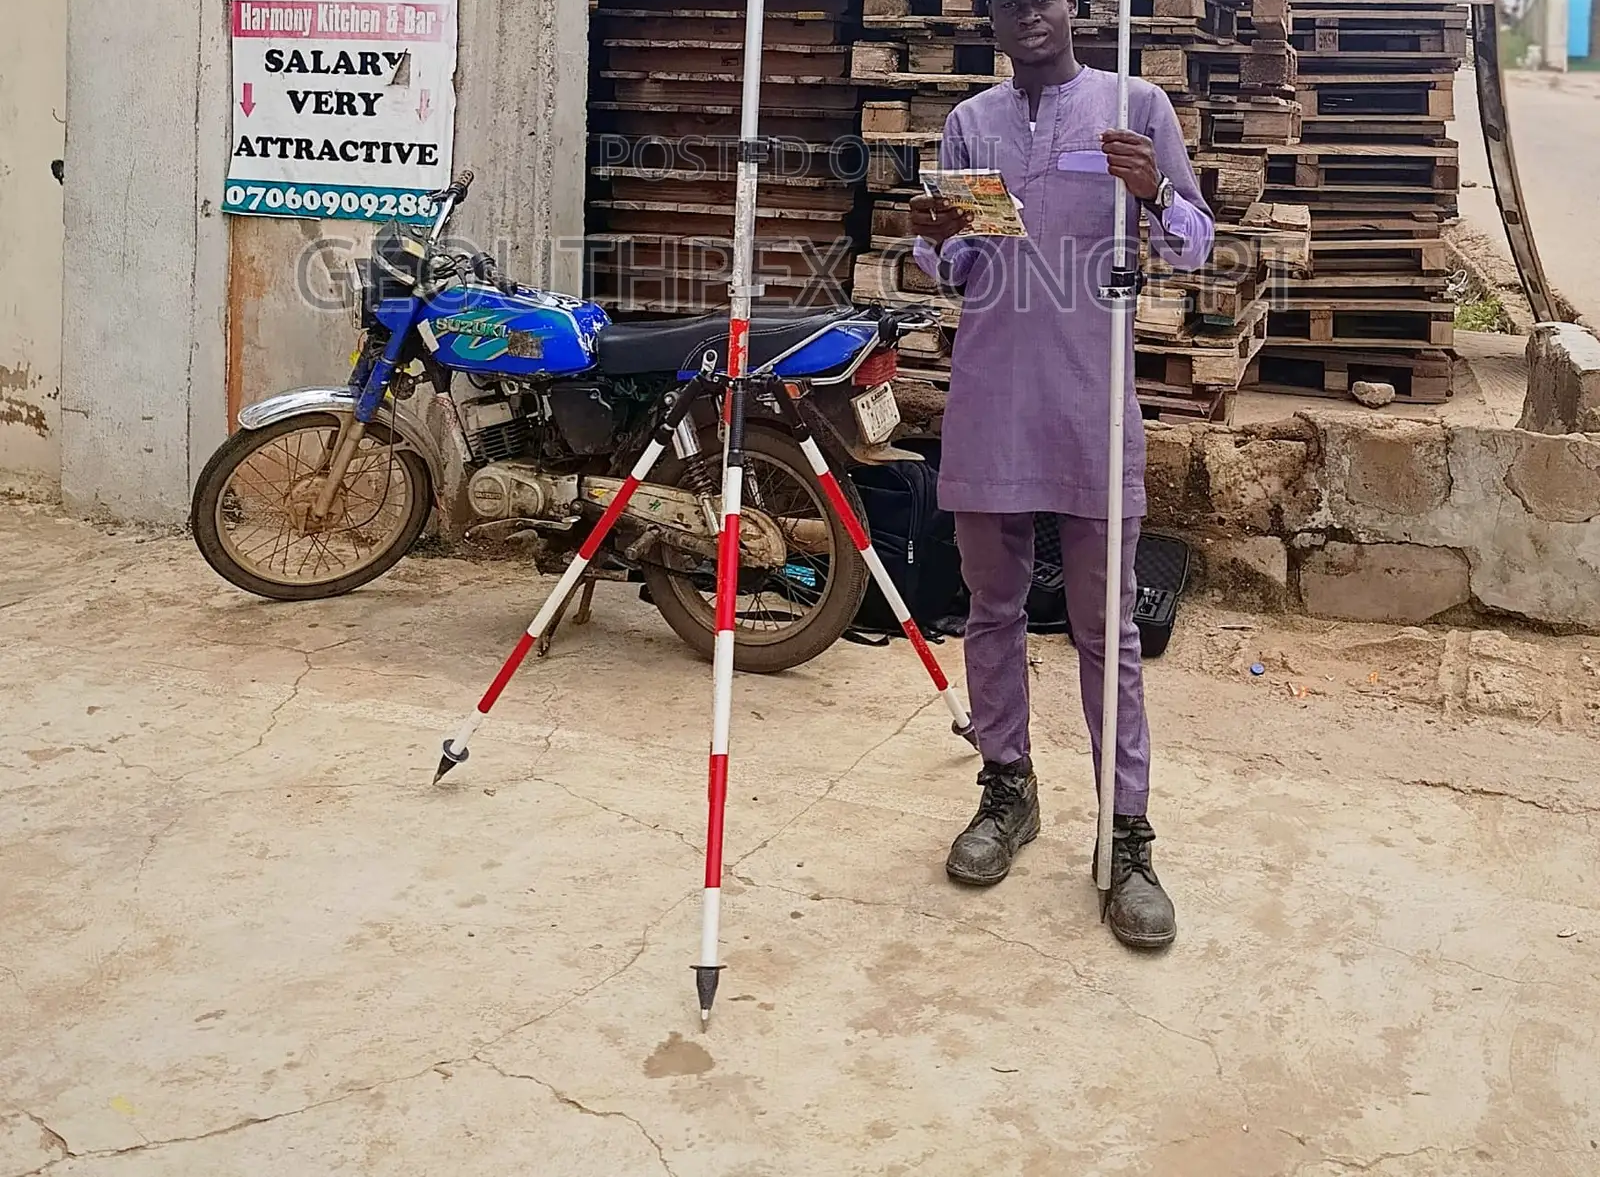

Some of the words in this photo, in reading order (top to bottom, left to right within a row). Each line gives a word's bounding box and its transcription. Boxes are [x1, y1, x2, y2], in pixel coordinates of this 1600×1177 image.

[241, 3, 312, 35] Harmony
[317, 4, 379, 31] Kitchen
[387, 8, 399, 32] &
[404, 6, 437, 34] Bar
[287, 89, 384, 116] VERY
[234, 135, 439, 166] ATTRACTIVE
[436, 317, 507, 337] SUZUKI
